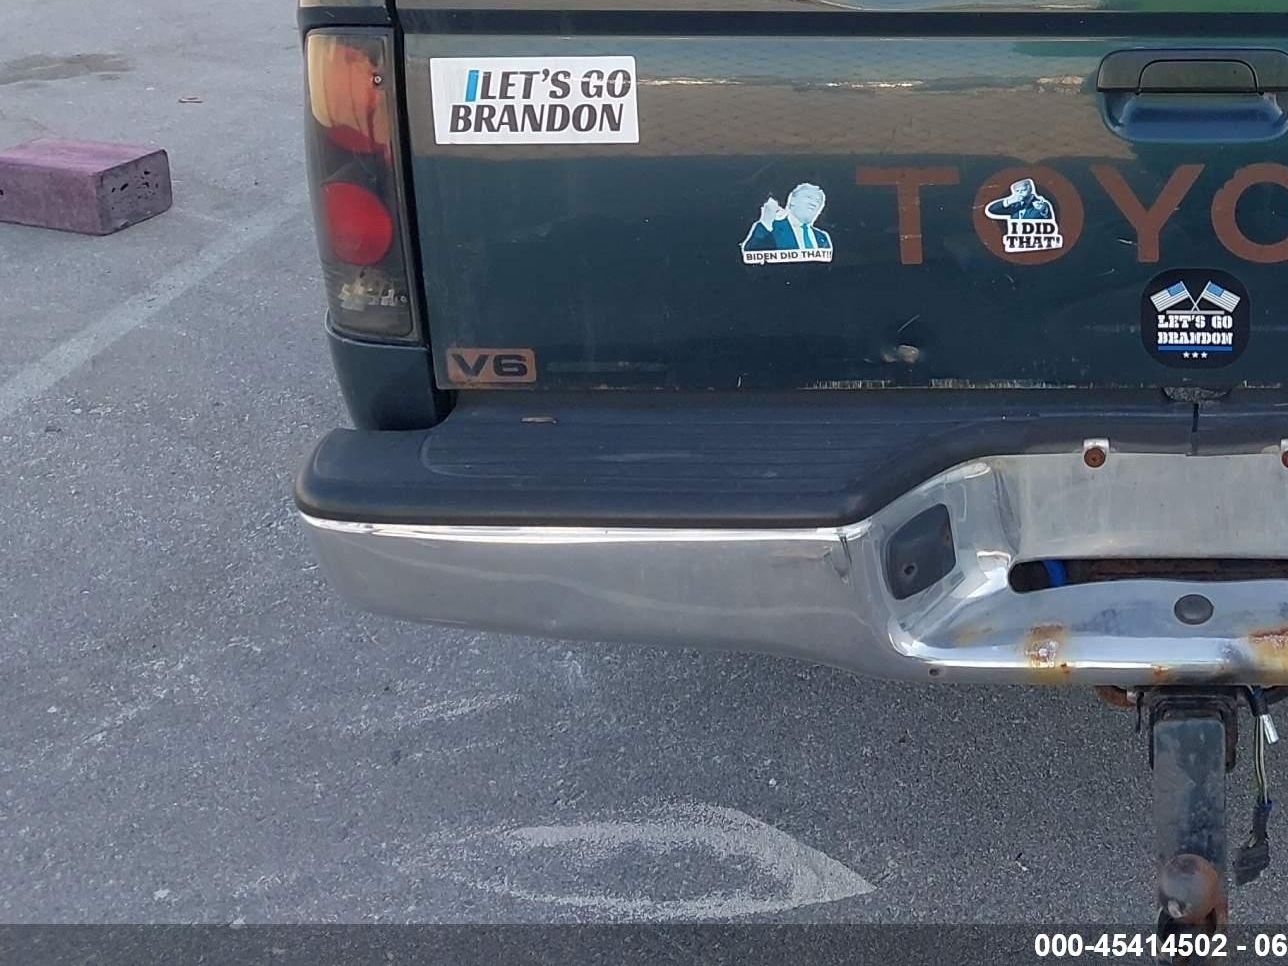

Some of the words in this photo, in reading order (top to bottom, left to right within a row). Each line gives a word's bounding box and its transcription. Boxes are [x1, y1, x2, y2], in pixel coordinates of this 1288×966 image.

[479, 68, 572, 101] LET'S
[580, 68, 632, 99] GO
[449, 103, 624, 133] BRANDON
[1011, 222, 1018, 235] I
[1021, 222, 1056, 235] DID
[1006, 235, 1061, 249] THAT!
[746, 252, 778, 261] BIDEN
[780, 251, 799, 260] DID
[800, 250, 832, 259] THAT!!
[1157, 314, 1206, 329] LET'S
[1211, 315, 1233, 329] GO
[1157, 331, 1234, 345] BRANDON
[450, 353, 528, 377] V6
